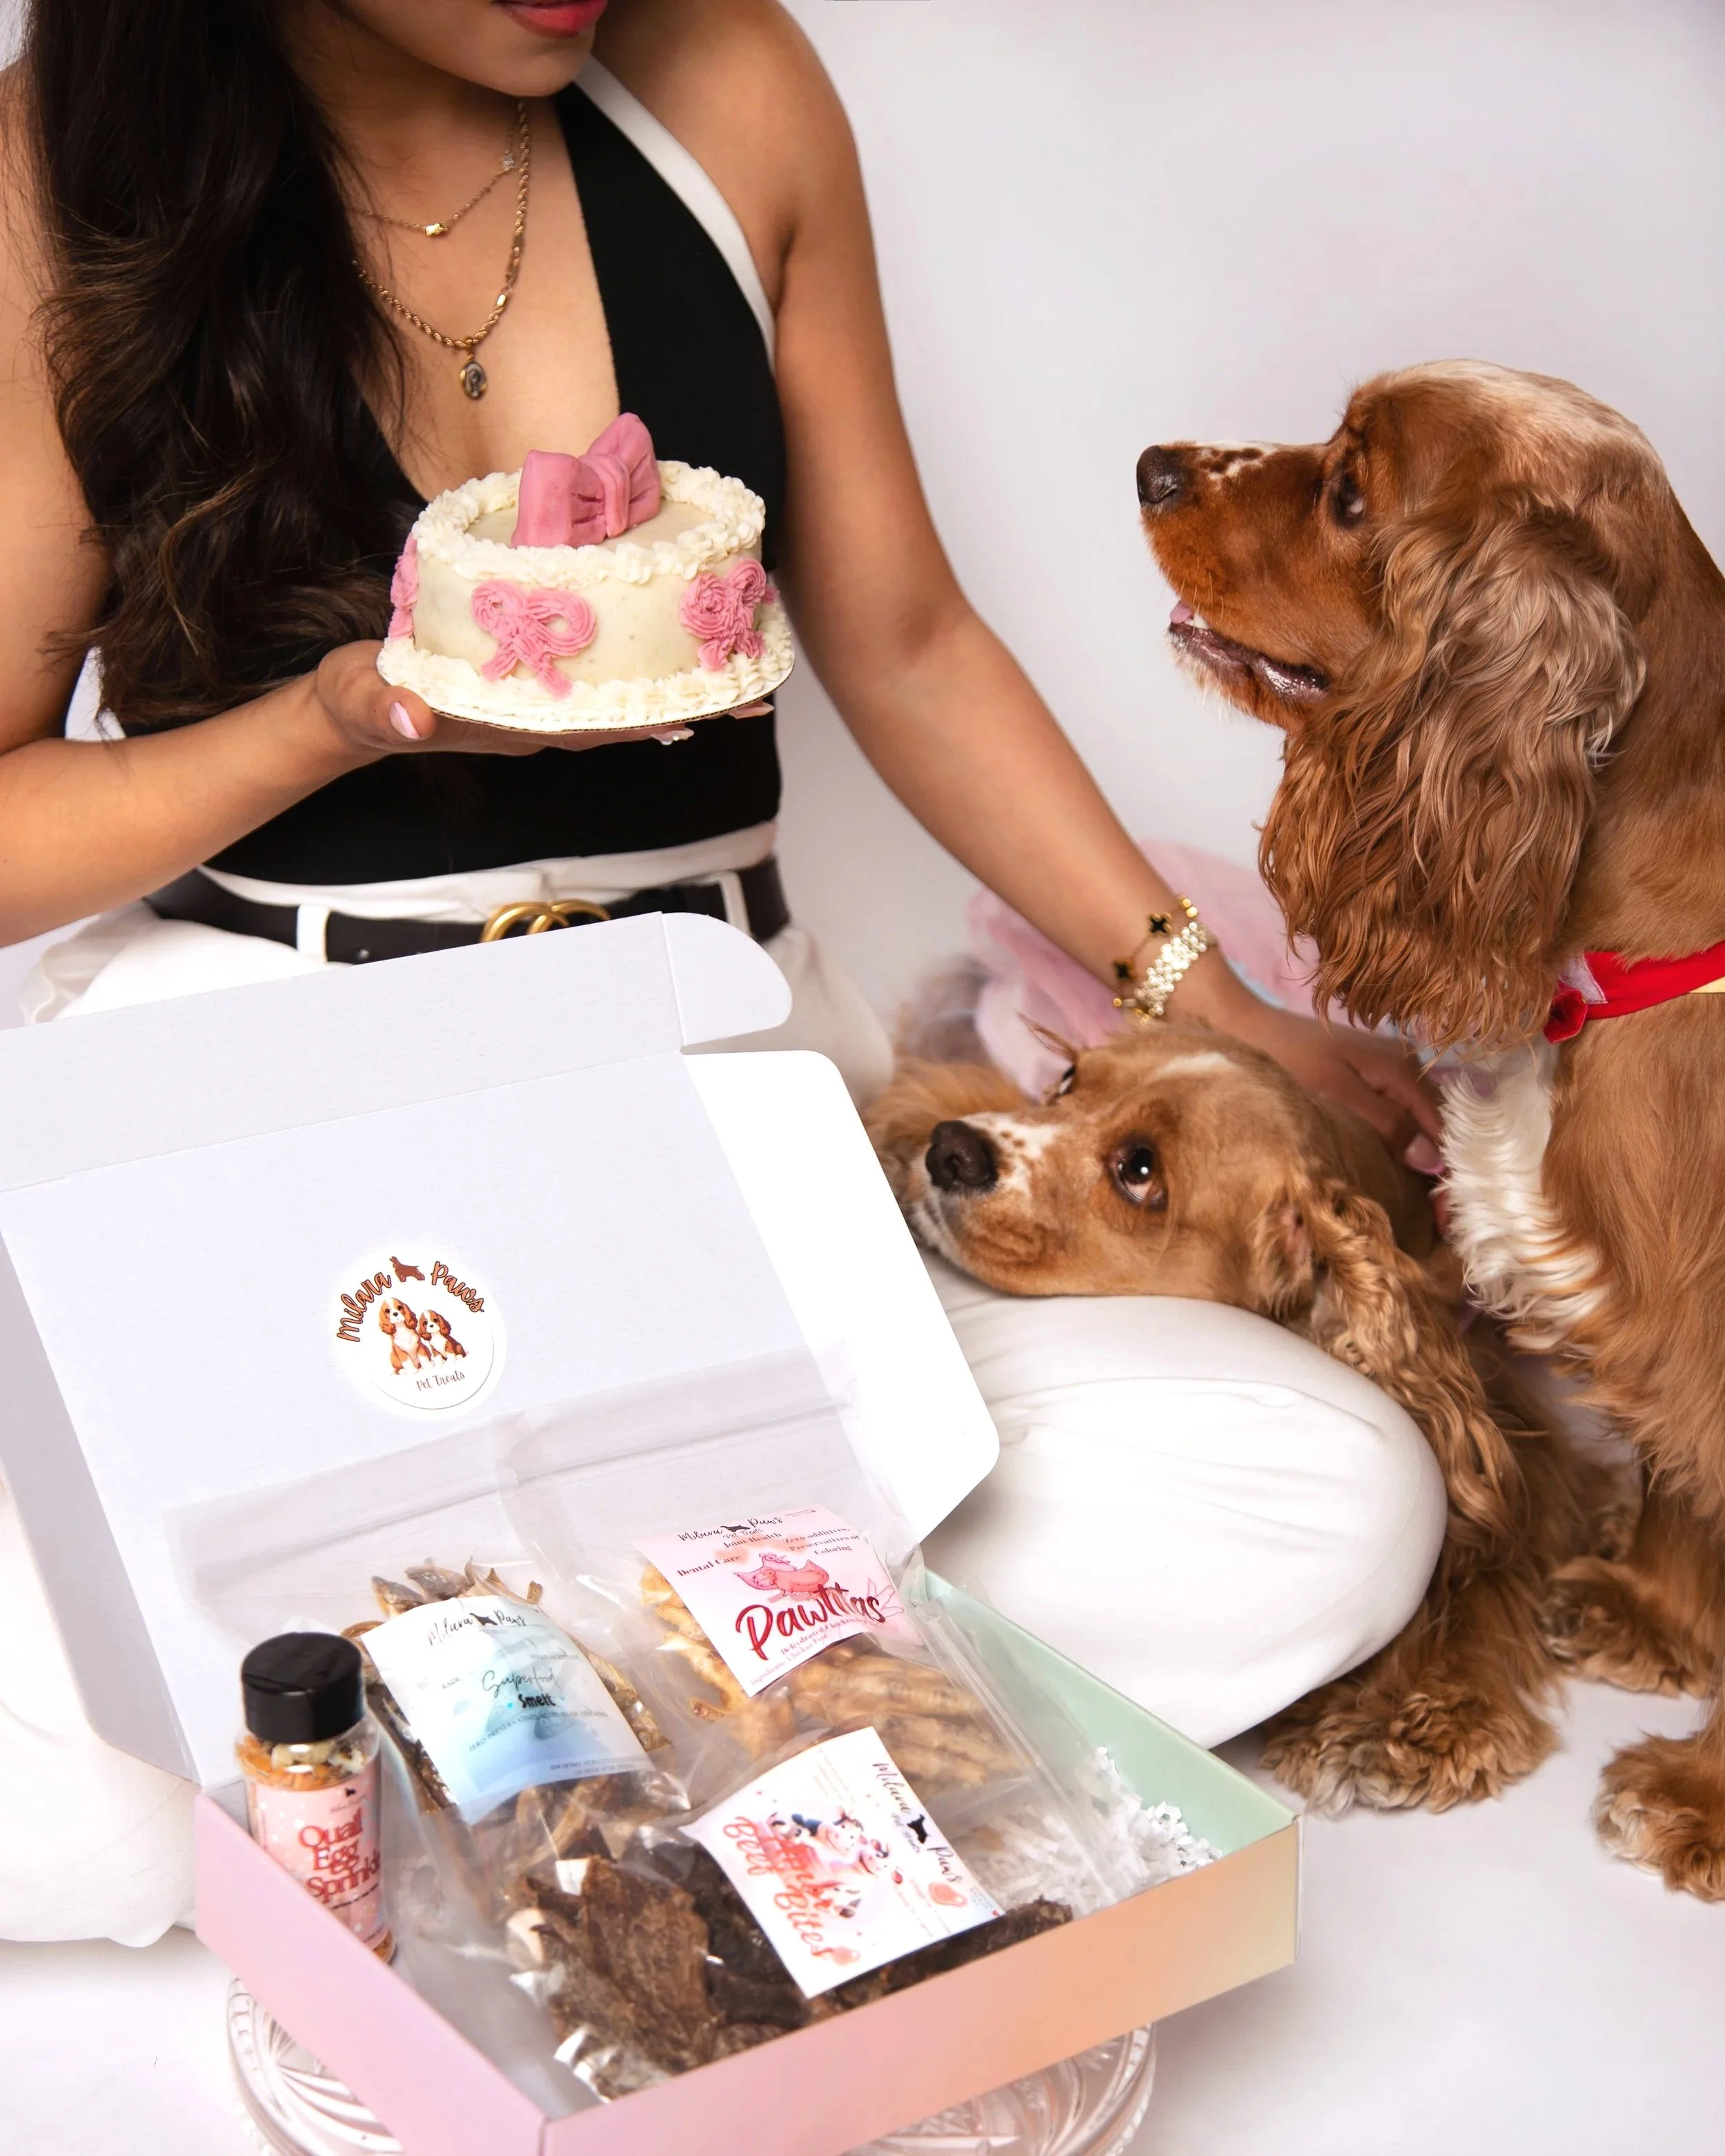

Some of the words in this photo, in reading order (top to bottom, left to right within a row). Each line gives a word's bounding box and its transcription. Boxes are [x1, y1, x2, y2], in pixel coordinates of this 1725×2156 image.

[336, 1272, 392, 1343] Milara
[431, 1260, 485, 1313] Paws
[416, 1378, 433, 1391] Pet
[432, 1370, 465, 1386] Treats
[747, 1516, 782, 1527] Paws
[723, 1539, 747, 1549] Joint
[748, 1532, 782, 1543] Health
[783, 1536, 805, 1544] Zero
[789, 1536, 850, 1551] Preservatives
[814, 1544, 853, 1555] Coloring
[676, 1561, 714, 1576] Dental
[715, 1554, 741, 1565] Care
[518, 1693, 556, 1709] Smelt
[297, 1806, 363, 1848] Quail
[723, 1815, 785, 1876] Beef
[313, 1839, 359, 1875] Egg
[773, 1883, 834, 1958] Bites
